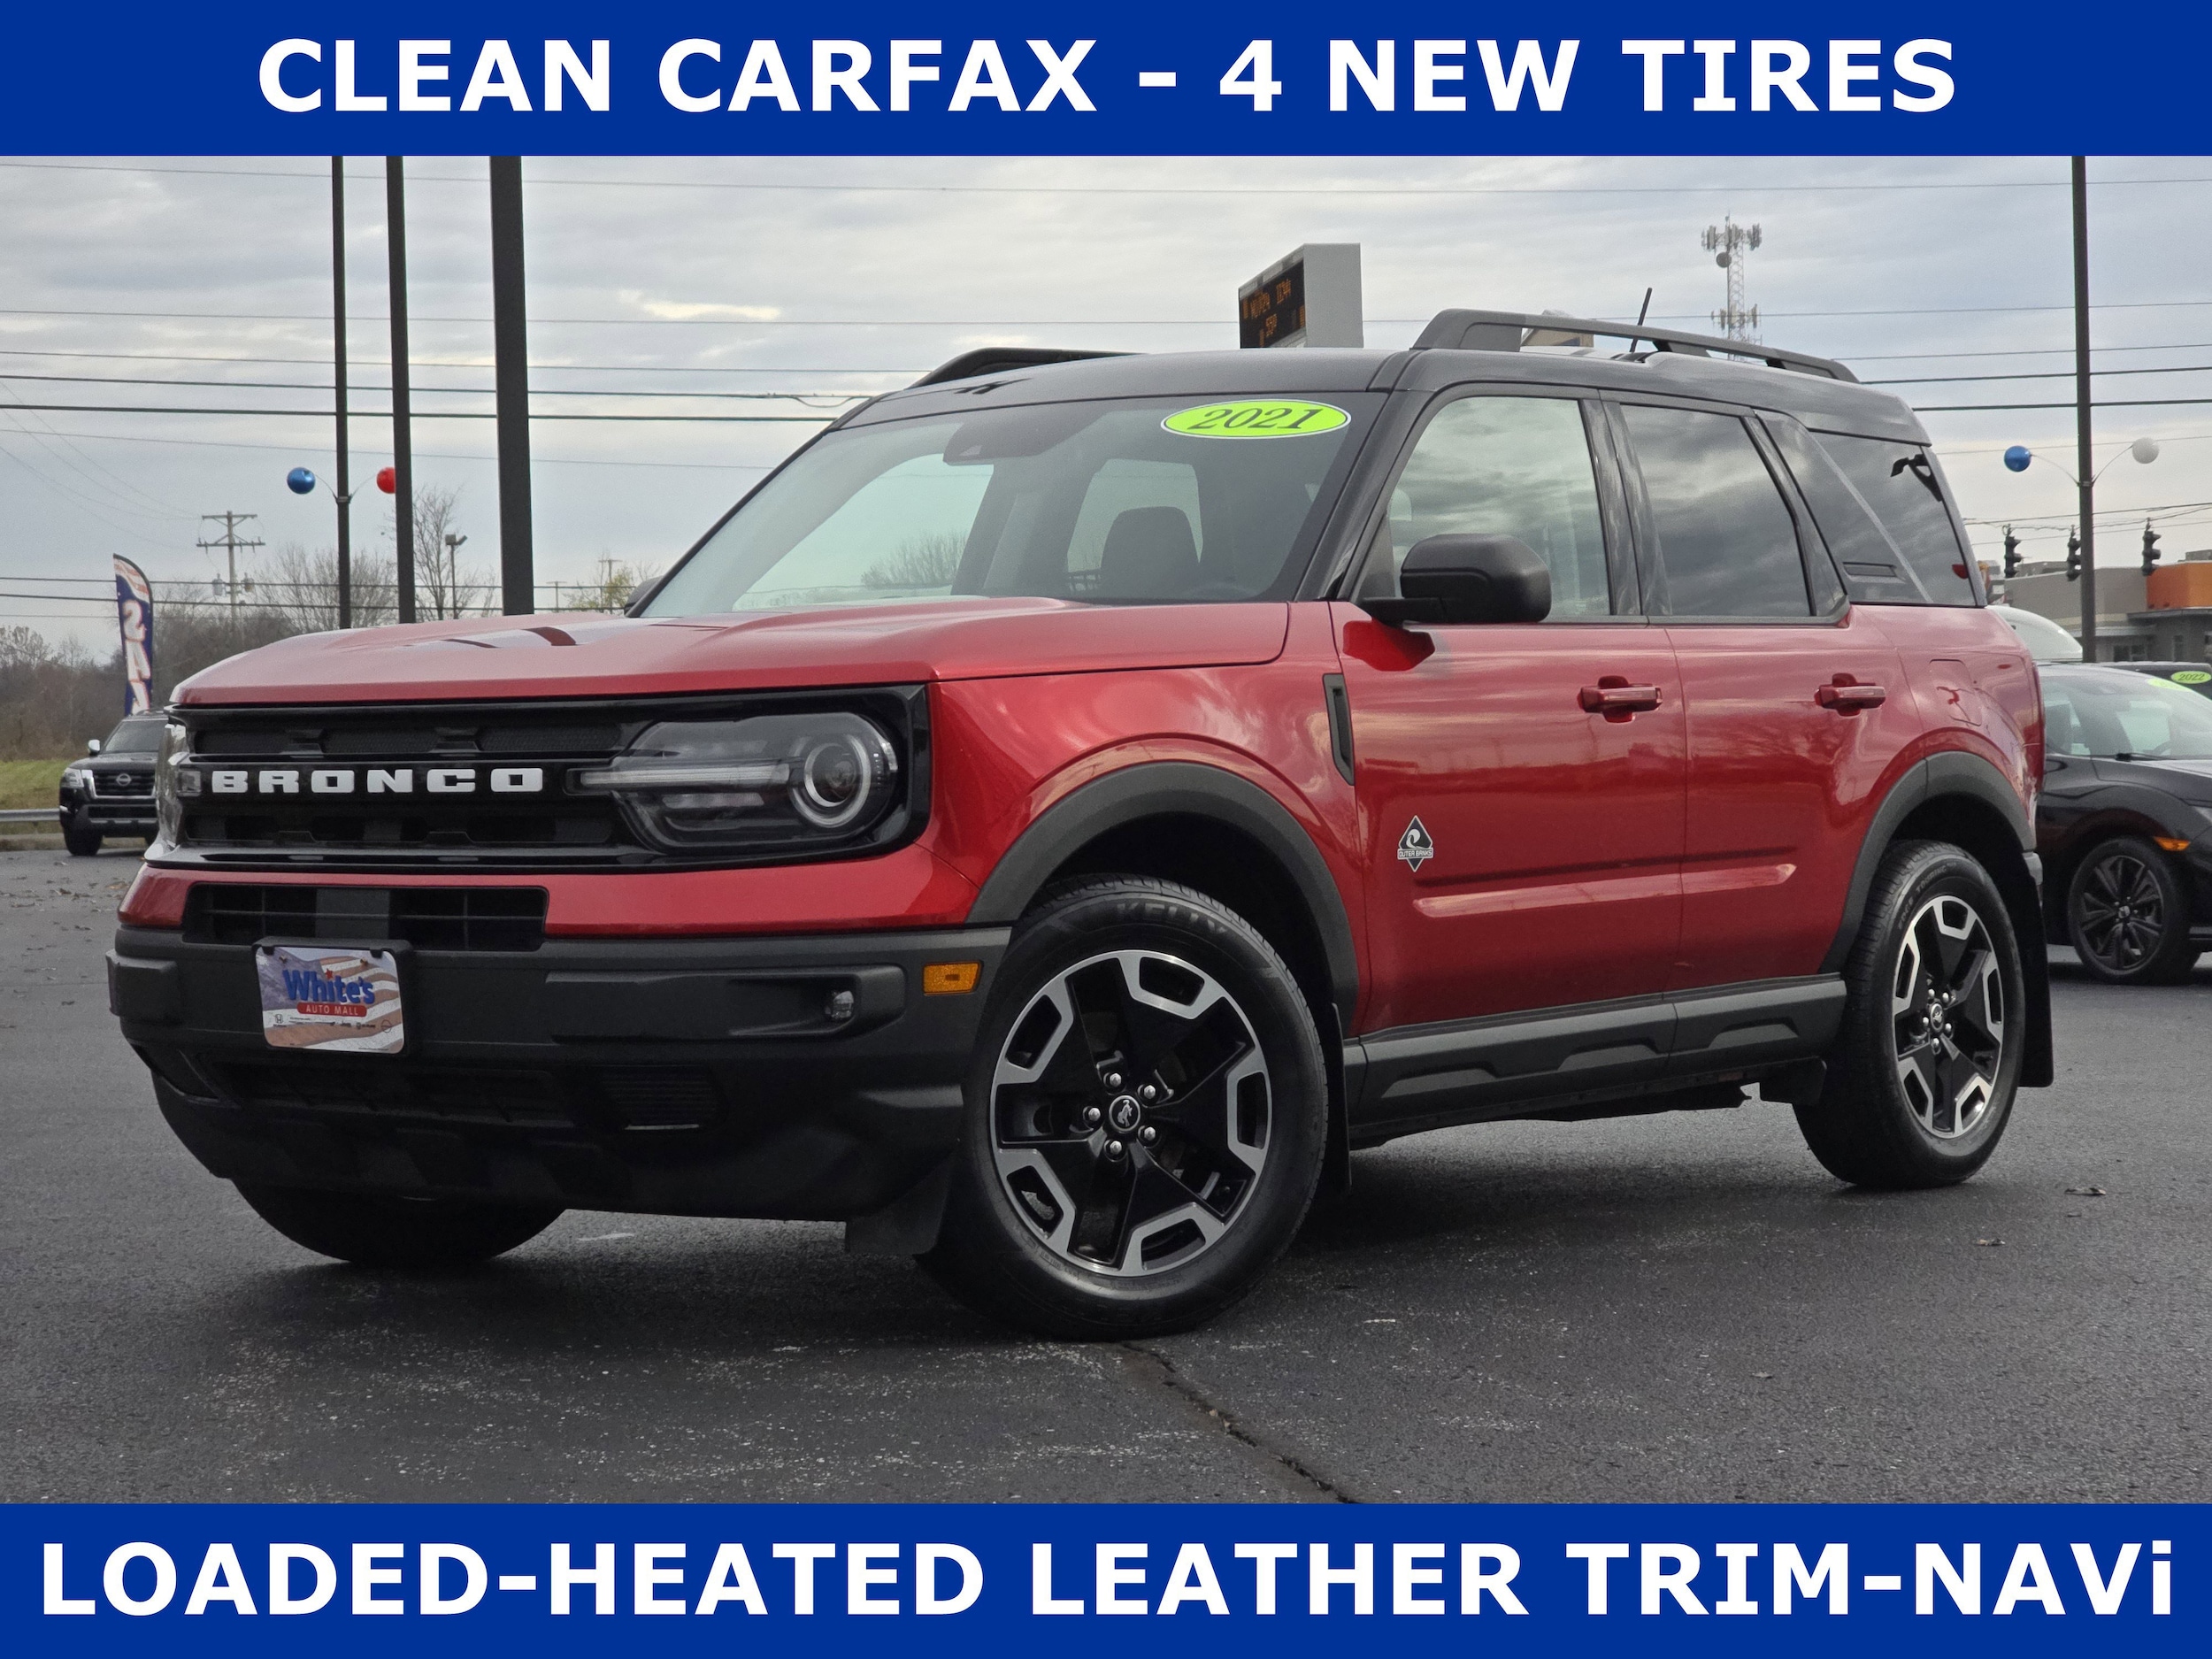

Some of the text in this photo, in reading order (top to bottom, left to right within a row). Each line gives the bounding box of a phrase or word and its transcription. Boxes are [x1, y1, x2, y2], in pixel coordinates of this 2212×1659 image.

[1187, 407, 1324, 430] 2021
[2177, 672, 2206, 681] 2022
[211, 767, 543, 794] BRONCO
[1117, 900, 1230, 934] KELLY
[281, 969, 376, 1004] White's
[306, 1005, 359, 1017] AUTO MALL
